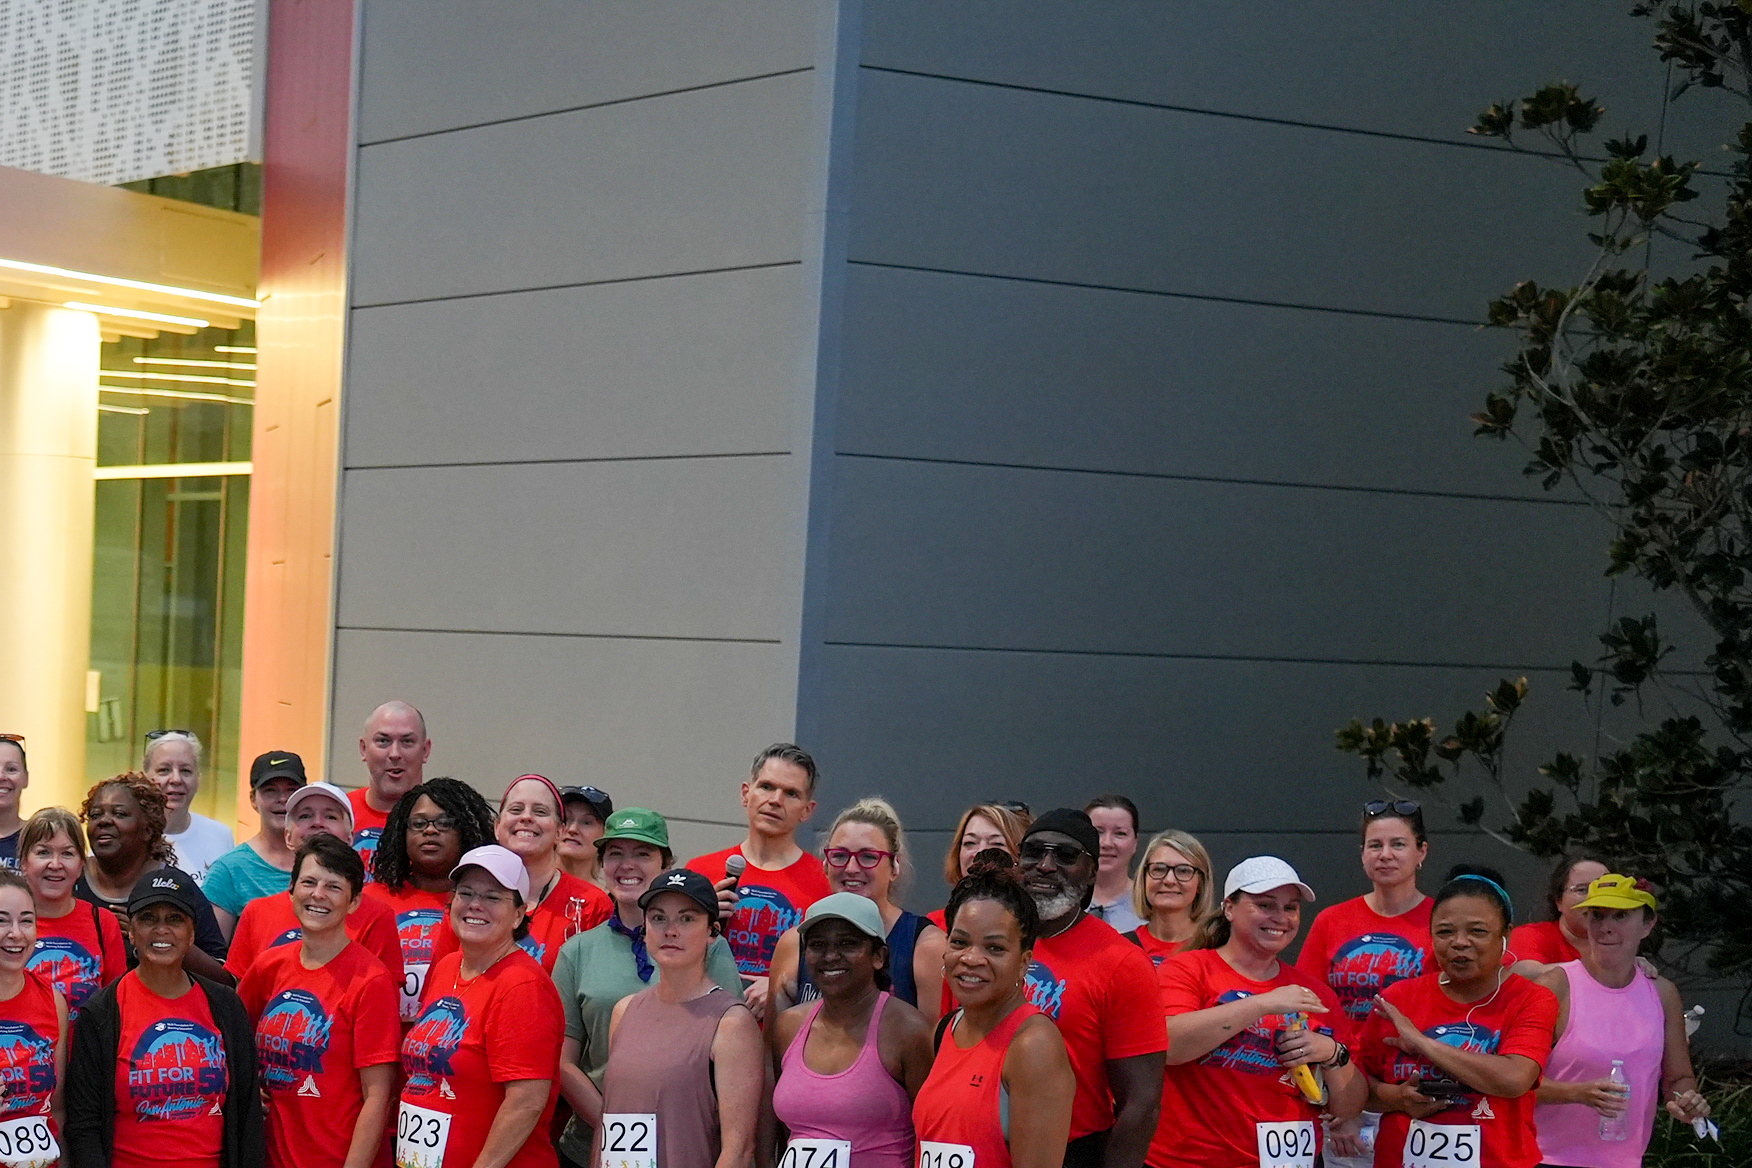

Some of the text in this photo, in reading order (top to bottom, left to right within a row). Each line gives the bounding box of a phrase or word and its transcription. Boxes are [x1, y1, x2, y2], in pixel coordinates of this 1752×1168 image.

[400, 938, 432, 948] FOR
[729, 929, 760, 945] FOR
[1348, 972, 1380, 986] FOR
[265, 1034, 290, 1052] FOR
[290, 1041, 324, 1074] 5K
[1224, 1045, 1284, 1069] Antonio
[2, 1066, 26, 1082] OR
[129, 1066, 195, 1086] FIT FOR
[1394, 1063, 1445, 1079] FIT FO
[130, 1082, 196, 1099] FUTURE
[159, 1095, 209, 1119] Antonio
[398, 1110, 441, 1148] 023
[1266, 1128, 1313, 1159] 092
[1410, 1128, 1474, 1162] 025
